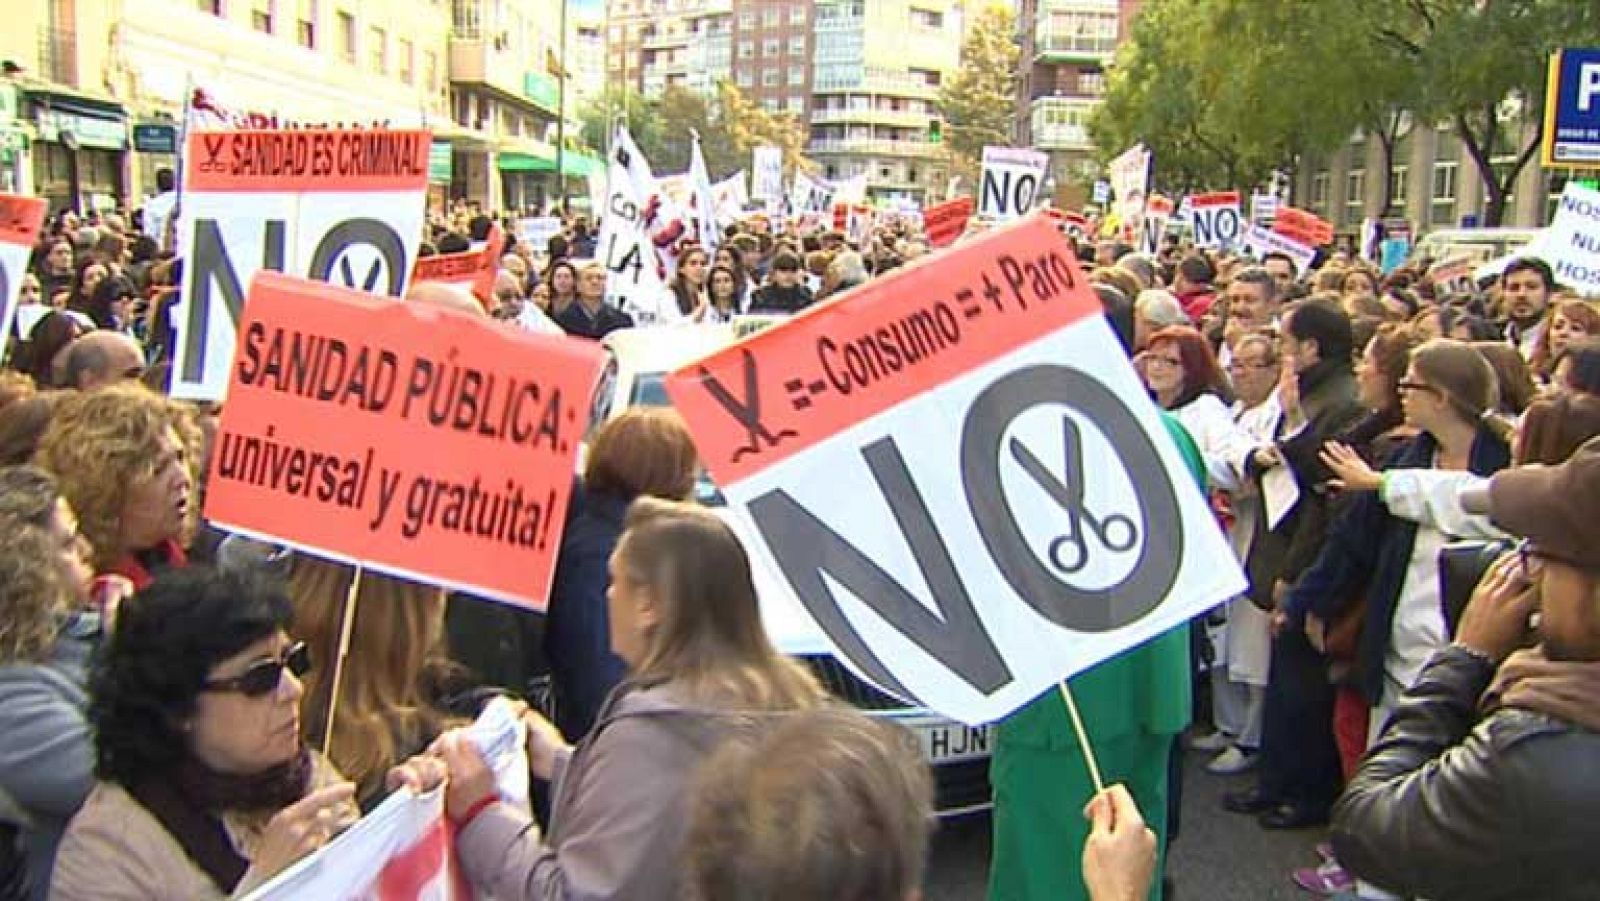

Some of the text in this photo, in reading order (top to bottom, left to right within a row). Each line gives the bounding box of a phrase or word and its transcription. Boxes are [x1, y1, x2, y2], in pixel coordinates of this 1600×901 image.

[231, 132, 425, 176] SANIDAD ES CRIMINAL
[982, 168, 1035, 216] NO
[1193, 208, 1238, 244] NO
[998, 252, 1075, 311] Paro
[237, 321, 577, 456] SANIDAD PÚBLICA:
[218, 424, 558, 551] universal y gratuita!
[745, 362, 1185, 708] NO
